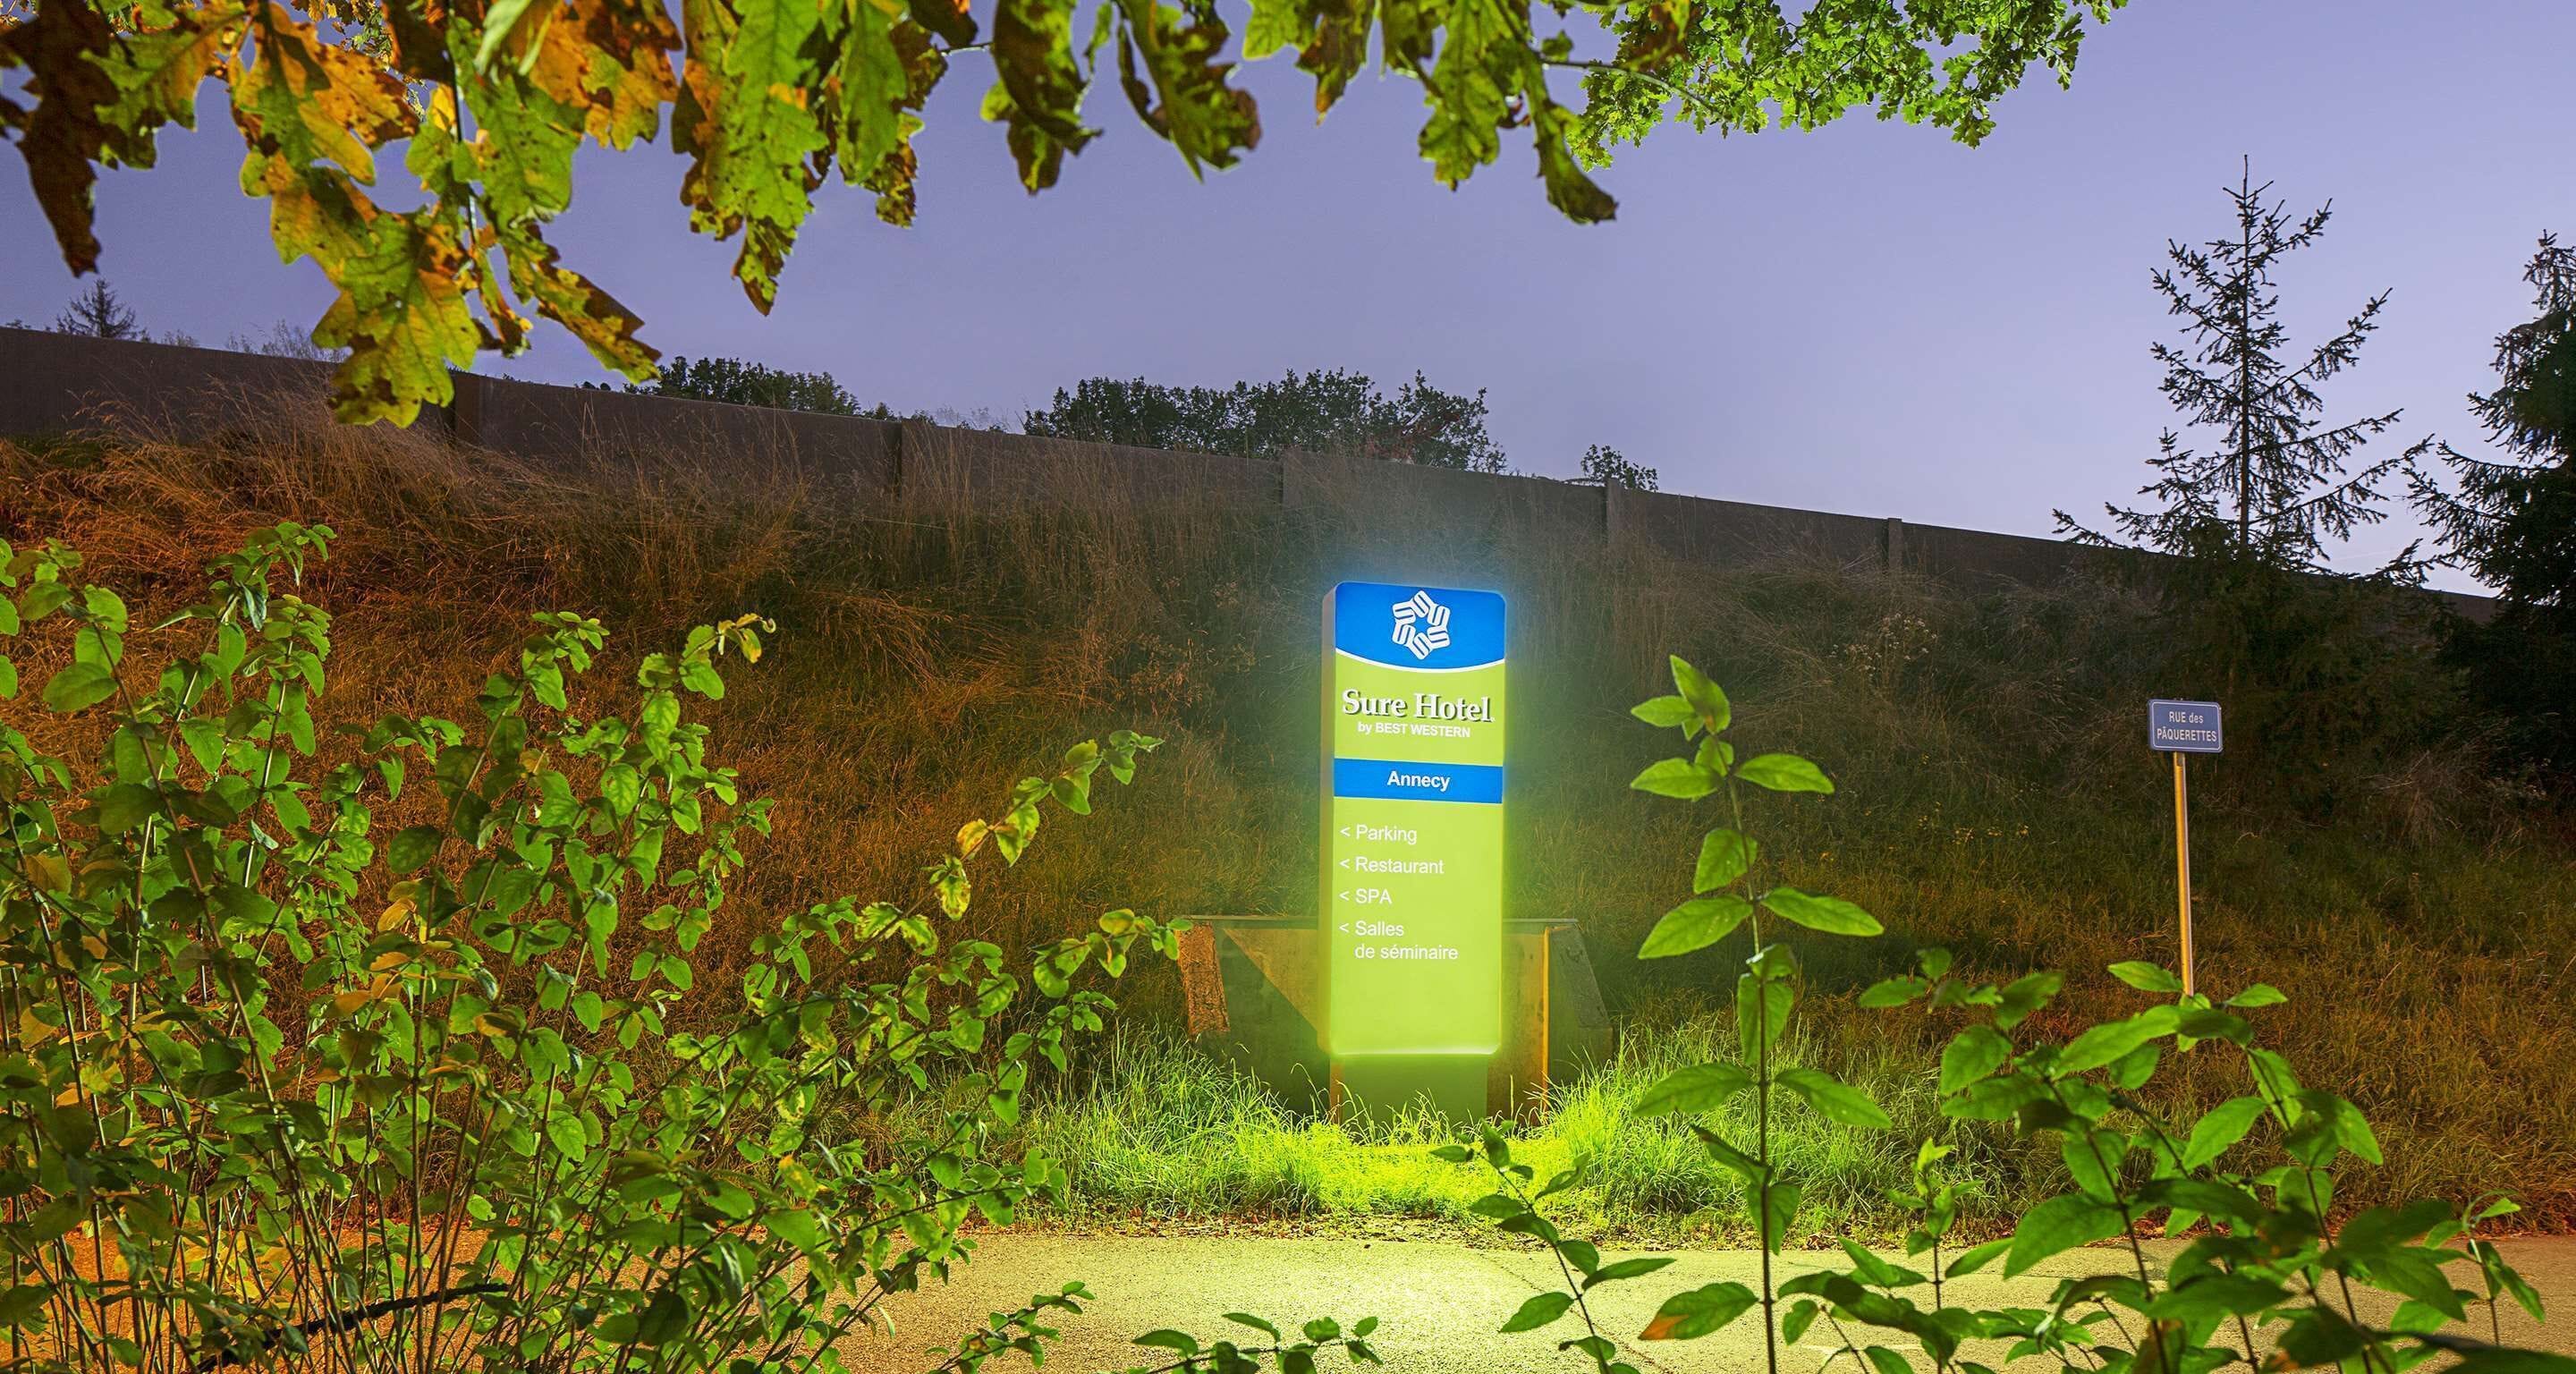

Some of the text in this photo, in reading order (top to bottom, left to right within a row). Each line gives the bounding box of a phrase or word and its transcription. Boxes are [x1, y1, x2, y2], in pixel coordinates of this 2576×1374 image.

[1343, 689, 1492, 722] Sure Hotel
[2168, 711, 2204, 724] RUE des
[1357, 722, 1470, 737] by BEST WESTERN
[2157, 725, 2217, 742] PÂQUERETTES
[1387, 770, 1451, 792] Annecy
[1355, 824, 1418, 845] Parking
[1355, 856, 1445, 874] Restaurant
[1355, 888, 1392, 904] SPA
[1355, 920, 1404, 937] Salles
[1354, 944, 1459, 960] de séminaire
